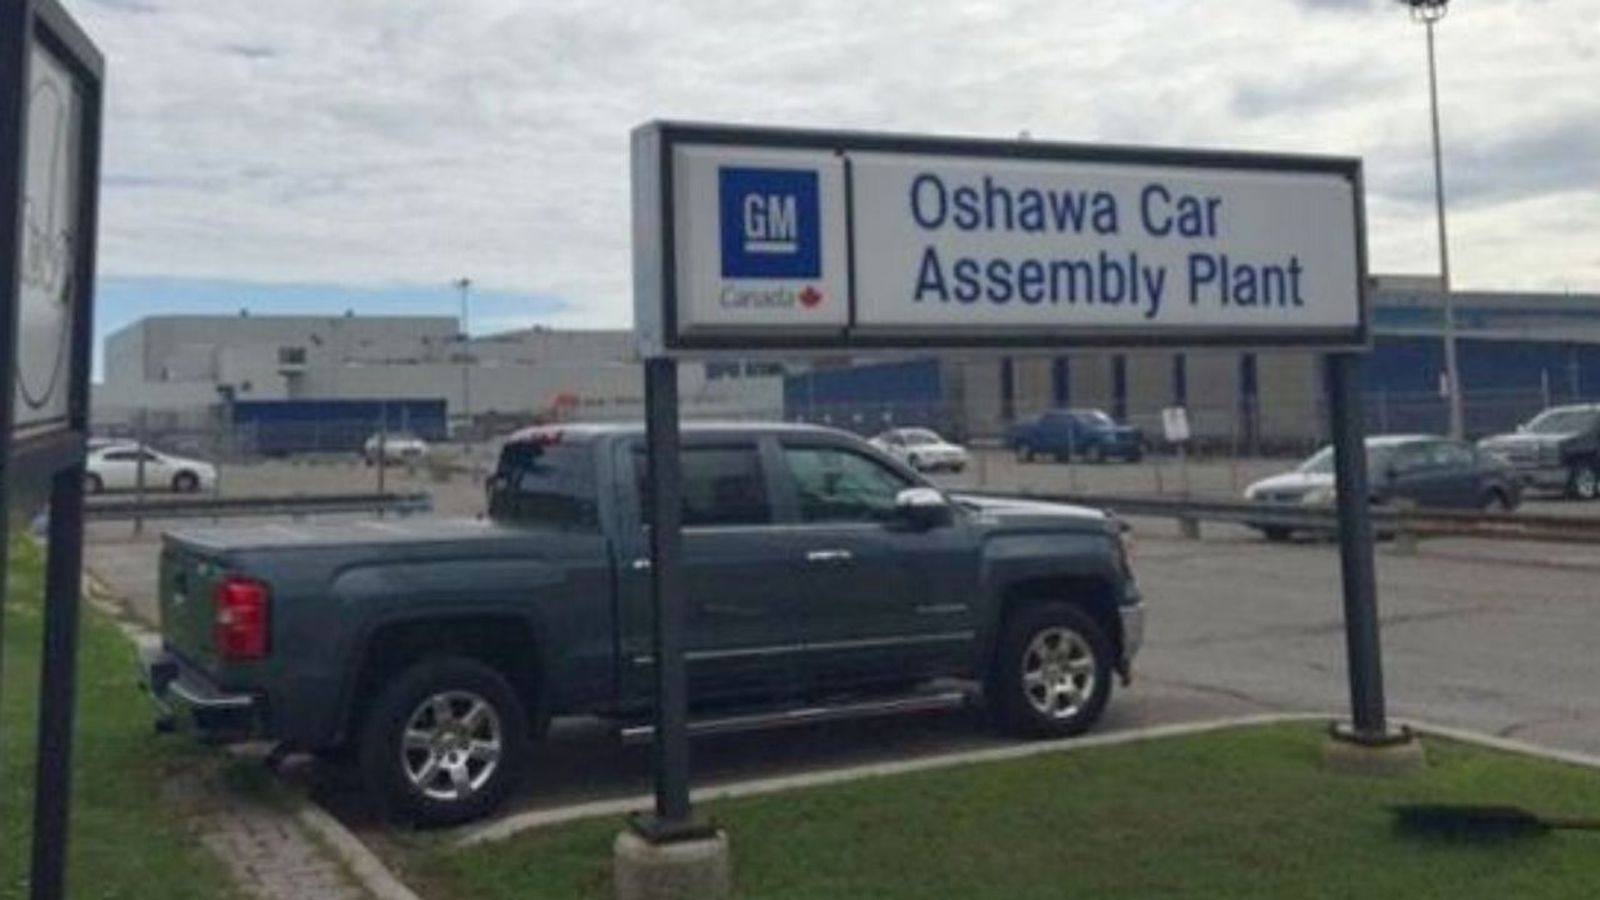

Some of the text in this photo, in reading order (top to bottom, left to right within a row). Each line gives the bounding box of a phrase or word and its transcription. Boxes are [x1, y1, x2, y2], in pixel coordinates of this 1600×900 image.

[743, 193, 797, 244] GM
[910, 174, 1222, 238] Oshawa Car
[719, 286, 795, 308] Canada
[914, 246, 1304, 318] Assembly Plant
